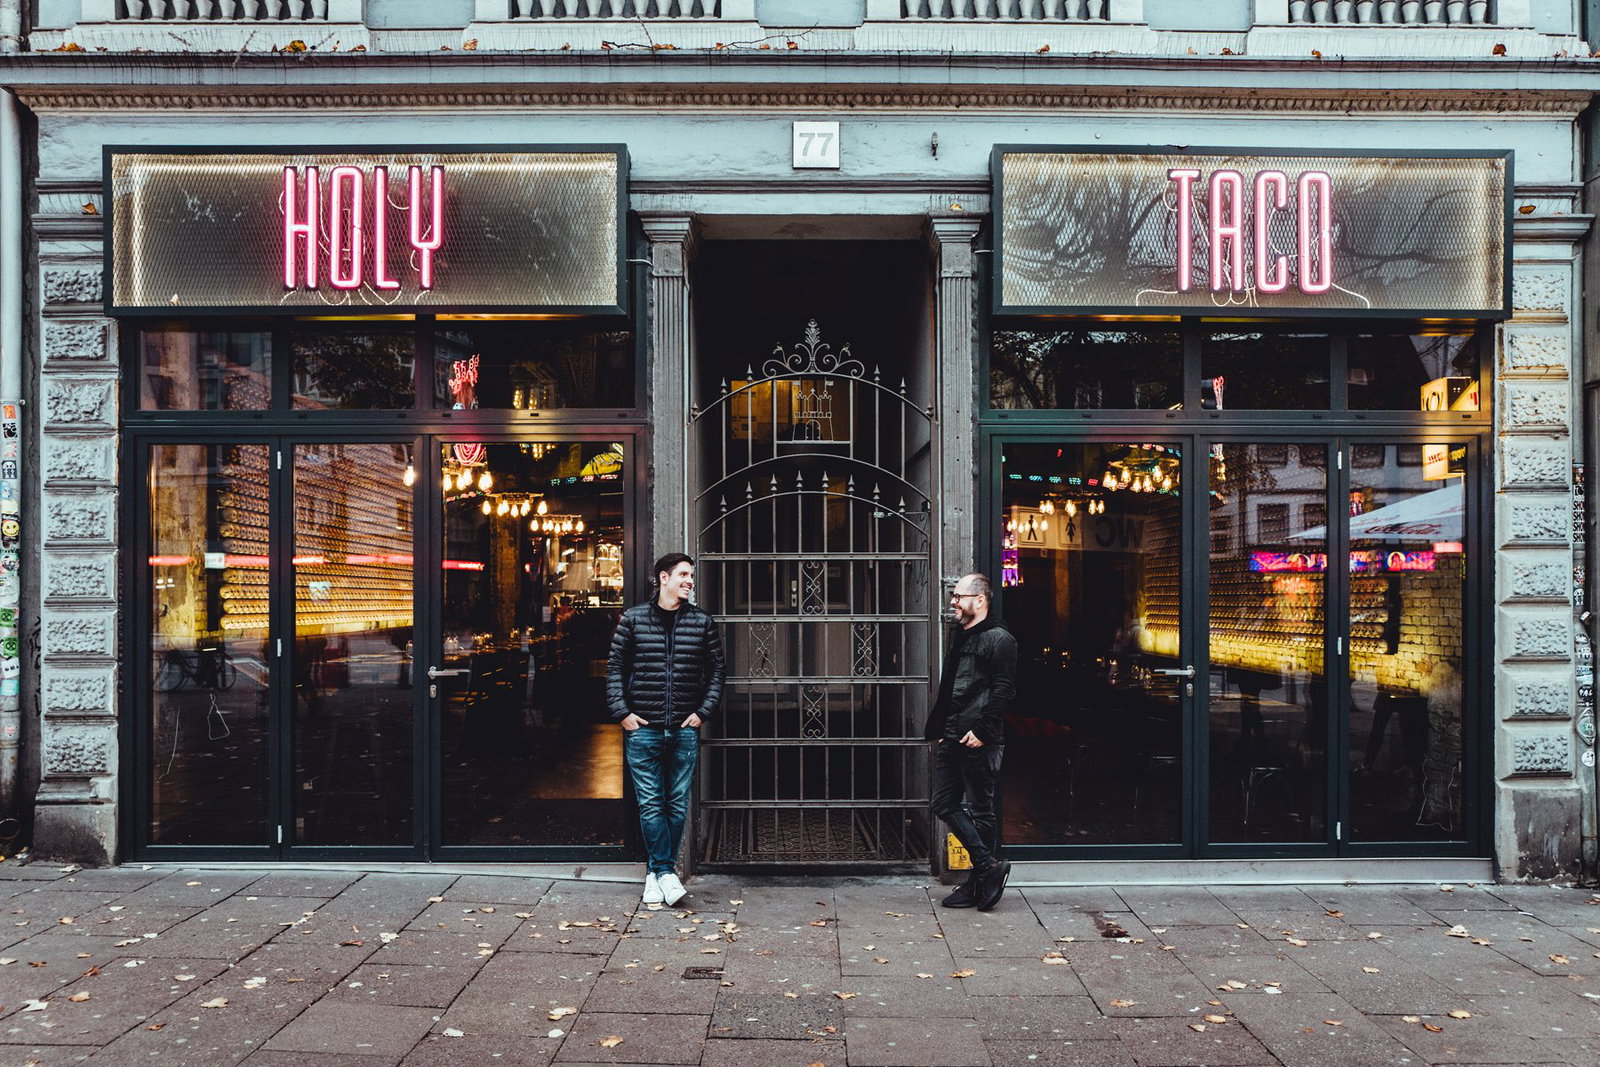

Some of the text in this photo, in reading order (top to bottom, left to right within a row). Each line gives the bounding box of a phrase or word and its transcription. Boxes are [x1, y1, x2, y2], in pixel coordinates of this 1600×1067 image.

[799, 133, 833, 156] 77
[283, 165, 445, 292] HOLY
[1167, 168, 1333, 295] TACO
